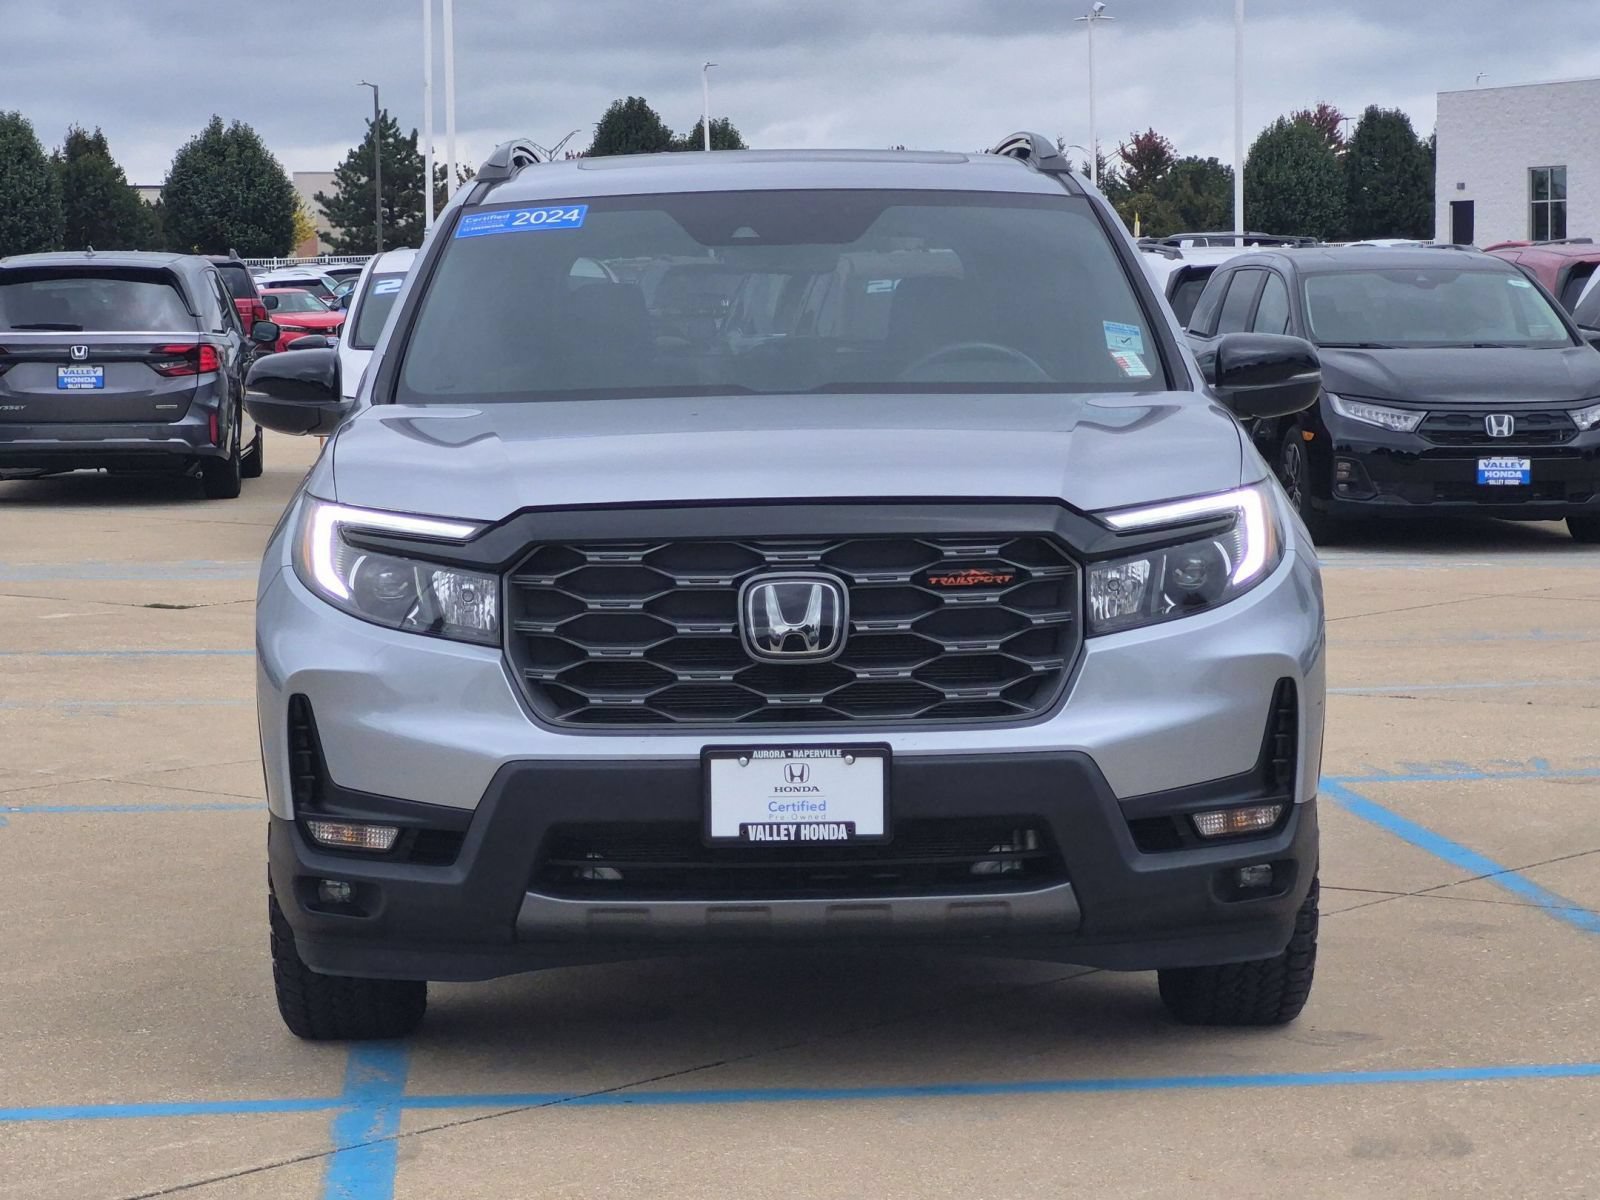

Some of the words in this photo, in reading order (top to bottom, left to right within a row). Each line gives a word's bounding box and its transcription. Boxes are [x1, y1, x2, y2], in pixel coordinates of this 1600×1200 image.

[465, 213, 510, 223] Certified
[511, 208, 581, 226] 2024
[928, 575, 1013, 585] TRAILSPORT
[752, 750, 786, 758] AURORA
[792, 749, 842, 758] NAPERVILLE
[768, 800, 826, 812] Certified
[748, 825, 797, 841] VALLEY
[801, 824, 848, 840] HONDA
